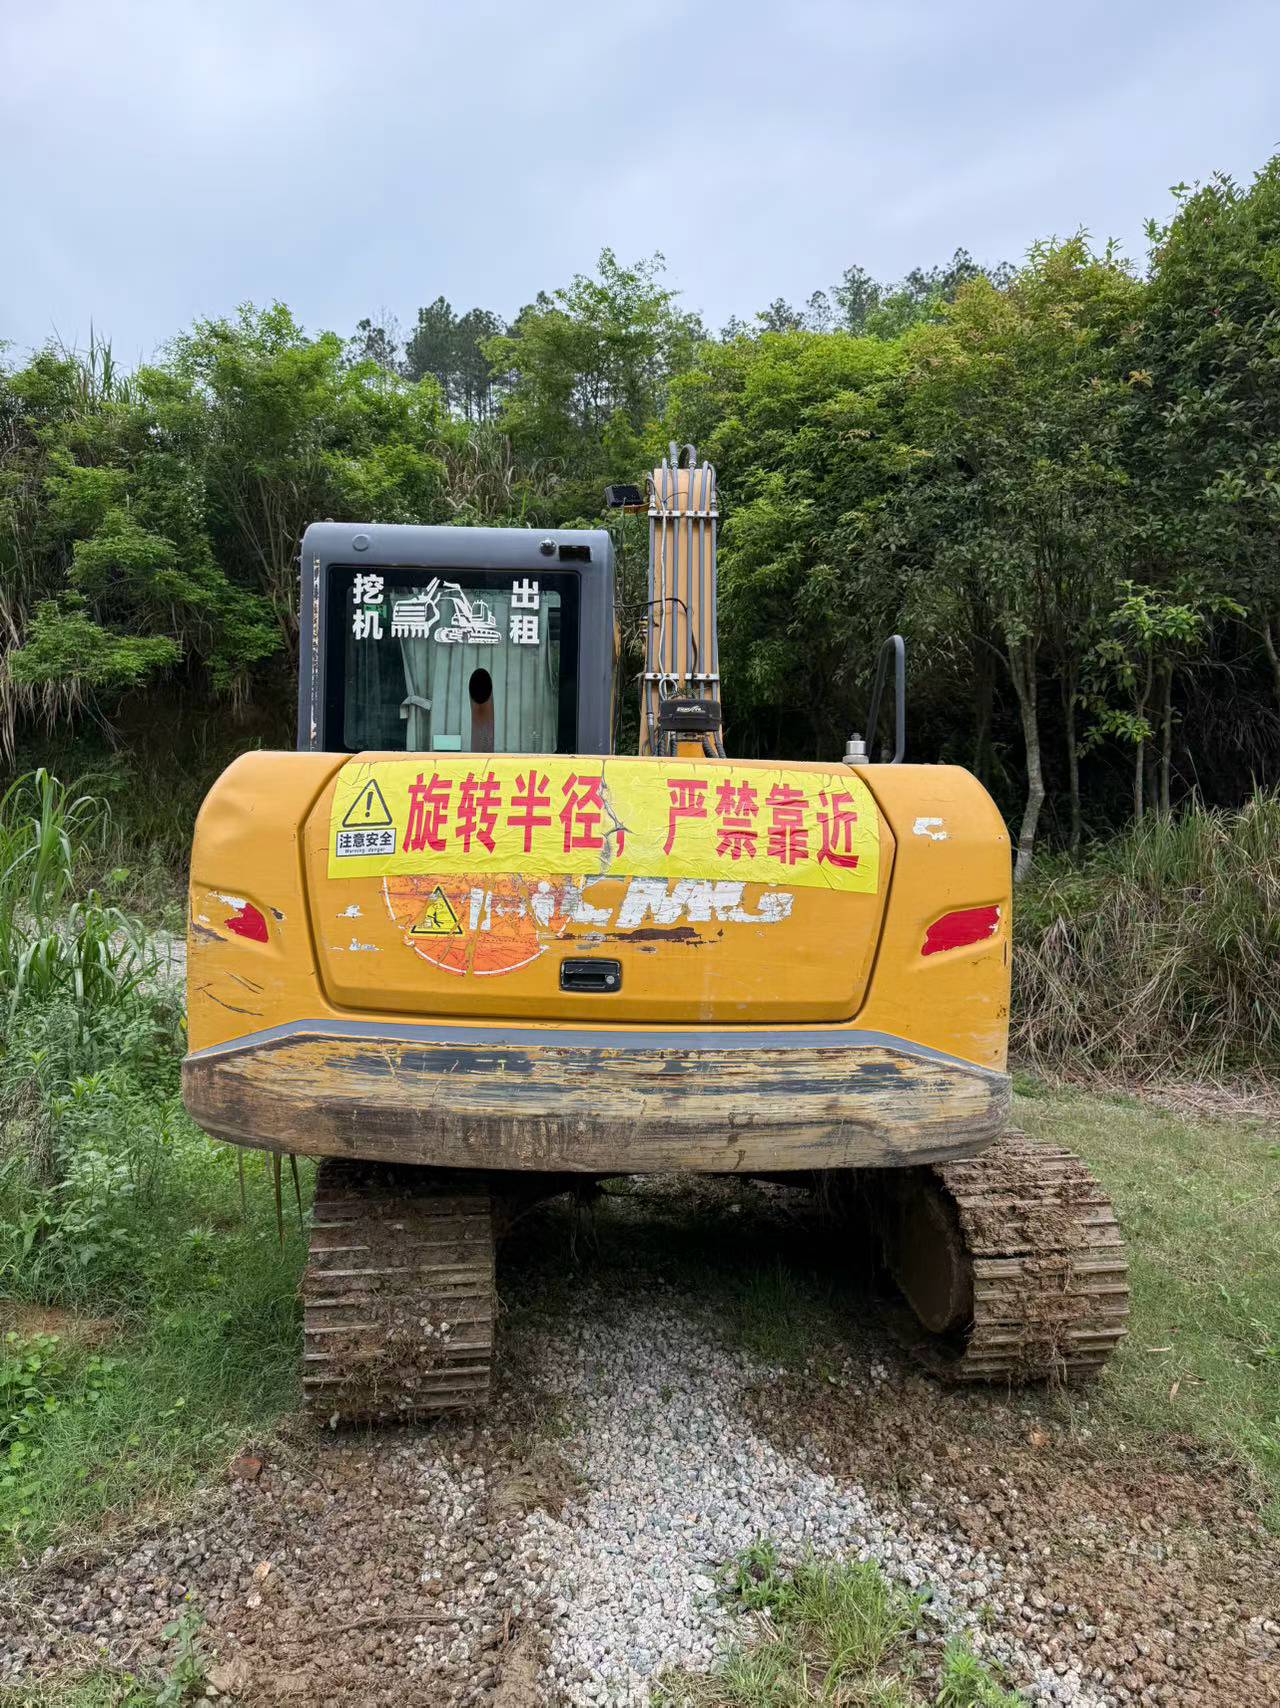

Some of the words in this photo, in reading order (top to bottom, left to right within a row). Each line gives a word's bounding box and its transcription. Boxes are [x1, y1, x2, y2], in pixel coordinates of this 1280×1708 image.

[352, 573, 384, 640] 挖机
[509, 578, 540, 645] 出租
[339, 831, 392, 849] 注意安全
